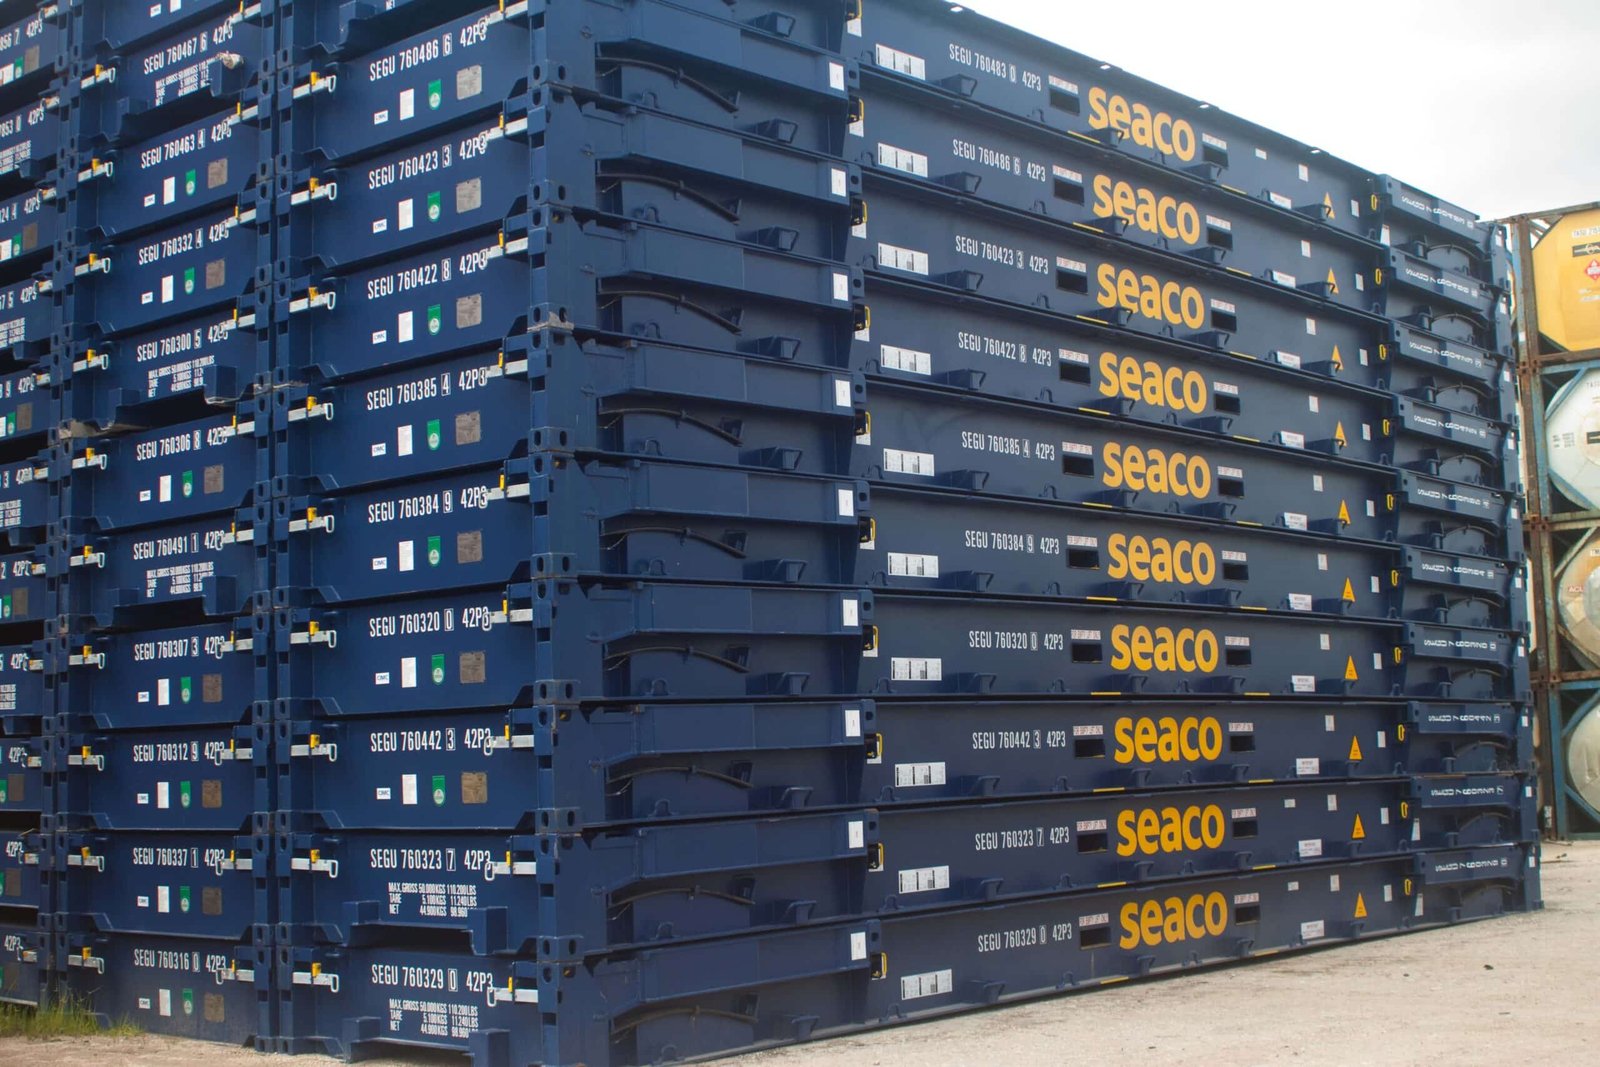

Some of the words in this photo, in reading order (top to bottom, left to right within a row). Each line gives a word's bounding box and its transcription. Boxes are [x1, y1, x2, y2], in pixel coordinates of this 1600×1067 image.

[143, 50, 165, 75] SEGU
[166, 37, 197, 66] 760467
[369, 55, 396, 82] SEGU
[399, 39, 439, 71] 760486
[949, 43, 972, 66] SEGU
[975, 53, 1007, 79] 760483
[1022, 70, 1042, 92] 42P3
[1088, 87, 1196, 162] seaco
[141, 147, 162, 169] SEGU
[164, 134, 195, 160] 760463
[952, 138, 975, 161] SEGU
[978, 147, 1011, 172] 760486
[1026, 162, 1046, 182] 42P3
[368, 164, 395, 190] SEGU
[398, 150, 438, 180] 760423
[1093, 174, 1200, 245] seaco
[138, 244, 159, 266] SEGU
[162, 232, 193, 258] 760332
[955, 235, 978, 257] SEGU
[981, 242, 1014, 266] 760423
[1029, 255, 1049, 275] 42P3
[367, 275, 394, 300] SEGU
[397, 263, 437, 292] 760422
[1097, 263, 1205, 329] seaco
[137, 341, 158, 362] SEGU
[160, 332, 191, 357] 760300
[958, 331, 981, 353] SEGU
[983, 337, 1016, 360] 760422
[1032, 347, 1052, 367] 42P3
[366, 387, 393, 411] SEGU
[397, 377, 437, 404] 760385
[1099, 352, 1207, 414] seaco
[136, 441, 157, 461] SEGU
[160, 433, 191, 456] 760306
[961, 431, 985, 451] SEGU
[987, 435, 1020, 456] 760385
[1035, 442, 1055, 461] 42P3
[1102, 441, 1212, 499] seaco
[368, 501, 395, 524] SEGU
[398, 494, 439, 519] 760384
[133, 540, 155, 560] SEGU
[157, 536, 188, 557] 760491
[965, 530, 988, 549] SEGU
[991, 532, 1024, 552] 760384
[1040, 536, 1060, 555] 42P3
[1107, 533, 1216, 586] seaco
[369, 615, 396, 637] SEGU
[400, 611, 440, 634] 760320
[969, 630, 991, 649] SEGU
[994, 631, 1027, 650] 760320
[1043, 632, 1063, 651] 42P3
[134, 642, 155, 661] SEGU
[157, 639, 188, 659] 760307
[1111, 624, 1219, 673] seaco
[133, 744, 154, 762] SEGU
[157, 743, 188, 761] 760312
[370, 732, 397, 752] SEGU
[400, 730, 441, 751] 760442
[972, 731, 995, 750] SEGU
[998, 730, 1030, 749] 760442
[1046, 730, 1066, 748] 42P3
[1114, 716, 1223, 764] seaco
[975, 832, 998, 851] SEGU
[1001, 829, 1034, 849] 760323
[1049, 826, 1070, 844] 42P3
[1116, 804, 1225, 857] seaco
[133, 847, 154, 865] SEGU
[156, 848, 188, 866] 760337
[370, 848, 397, 868] SEGU
[400, 849, 442, 869] 760323
[464, 850, 491, 870] 42P3
[1120, 891, 1228, 950] seaco
[978, 934, 1001, 953] SEGU
[1003, 928, 1036, 949] 760329
[1052, 923, 1072, 941] 42P3
[134, 948, 155, 968] SEGU
[158, 950, 189, 970] 760316
[371, 964, 398, 985] SEGU
[402, 967, 444, 989] 760329
[466, 971, 493, 993] 42P3
